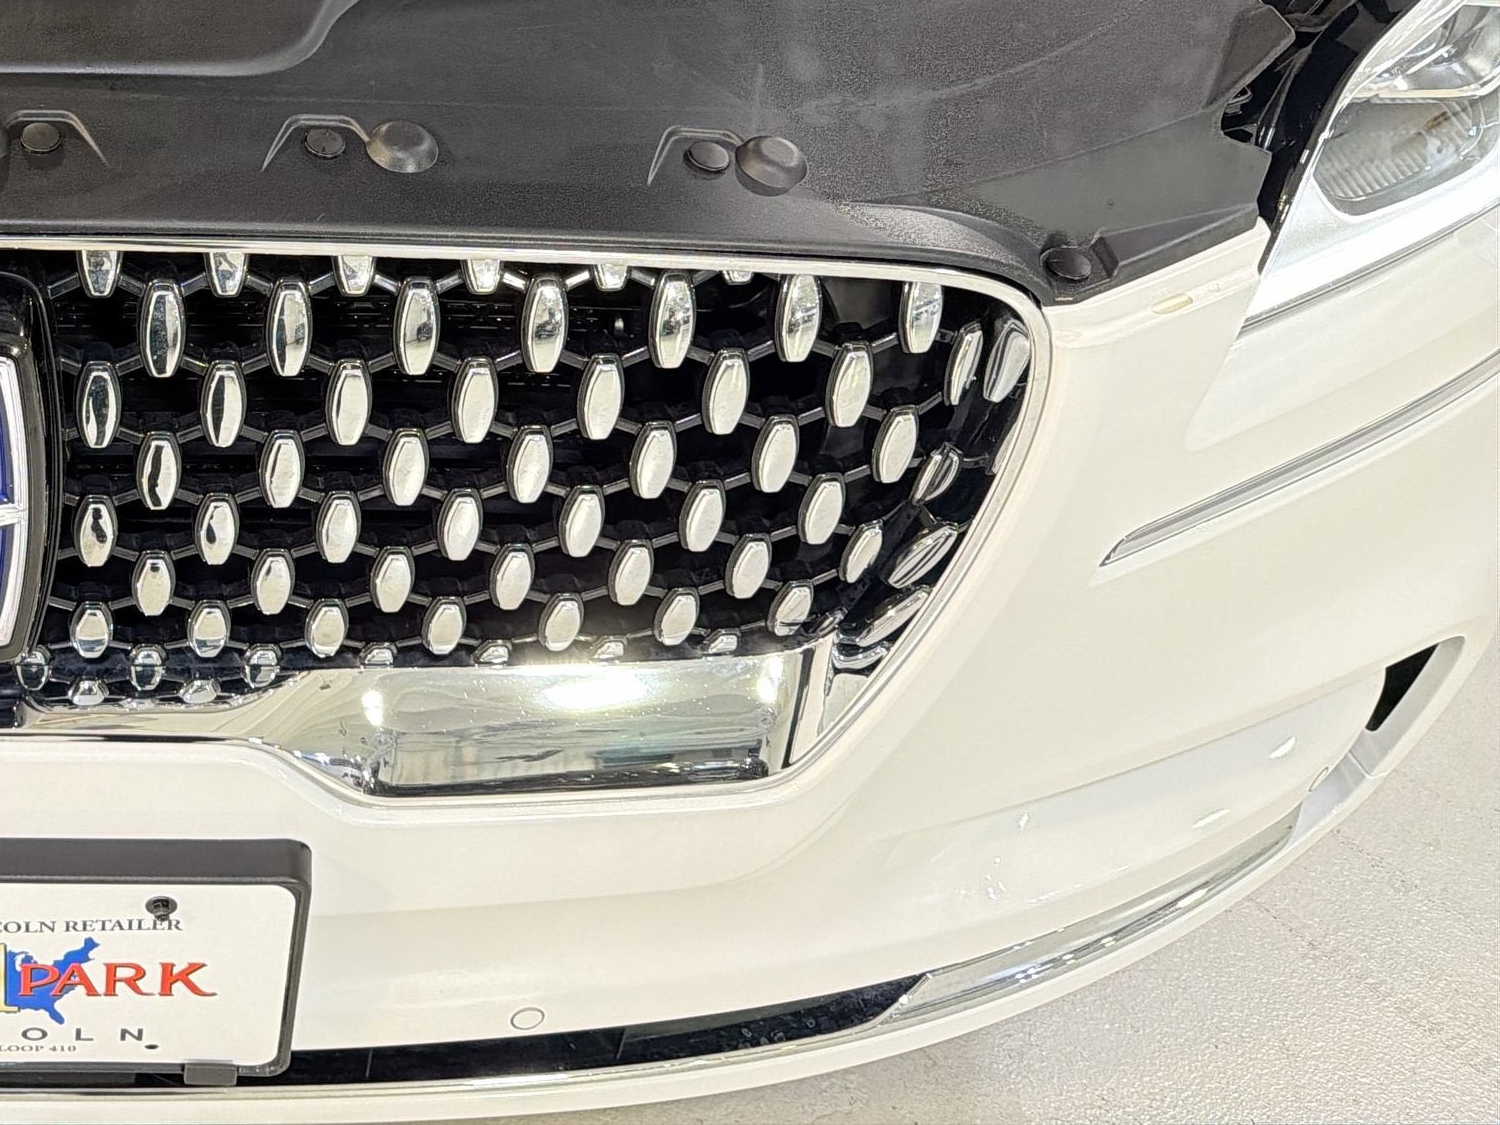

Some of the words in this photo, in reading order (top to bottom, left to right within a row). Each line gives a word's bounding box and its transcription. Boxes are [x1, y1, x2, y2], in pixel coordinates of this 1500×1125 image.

[64, 918, 184, 933] RETAILER
[18, 962, 219, 997] PARK
[49, 1044, 77, 1053] 410
